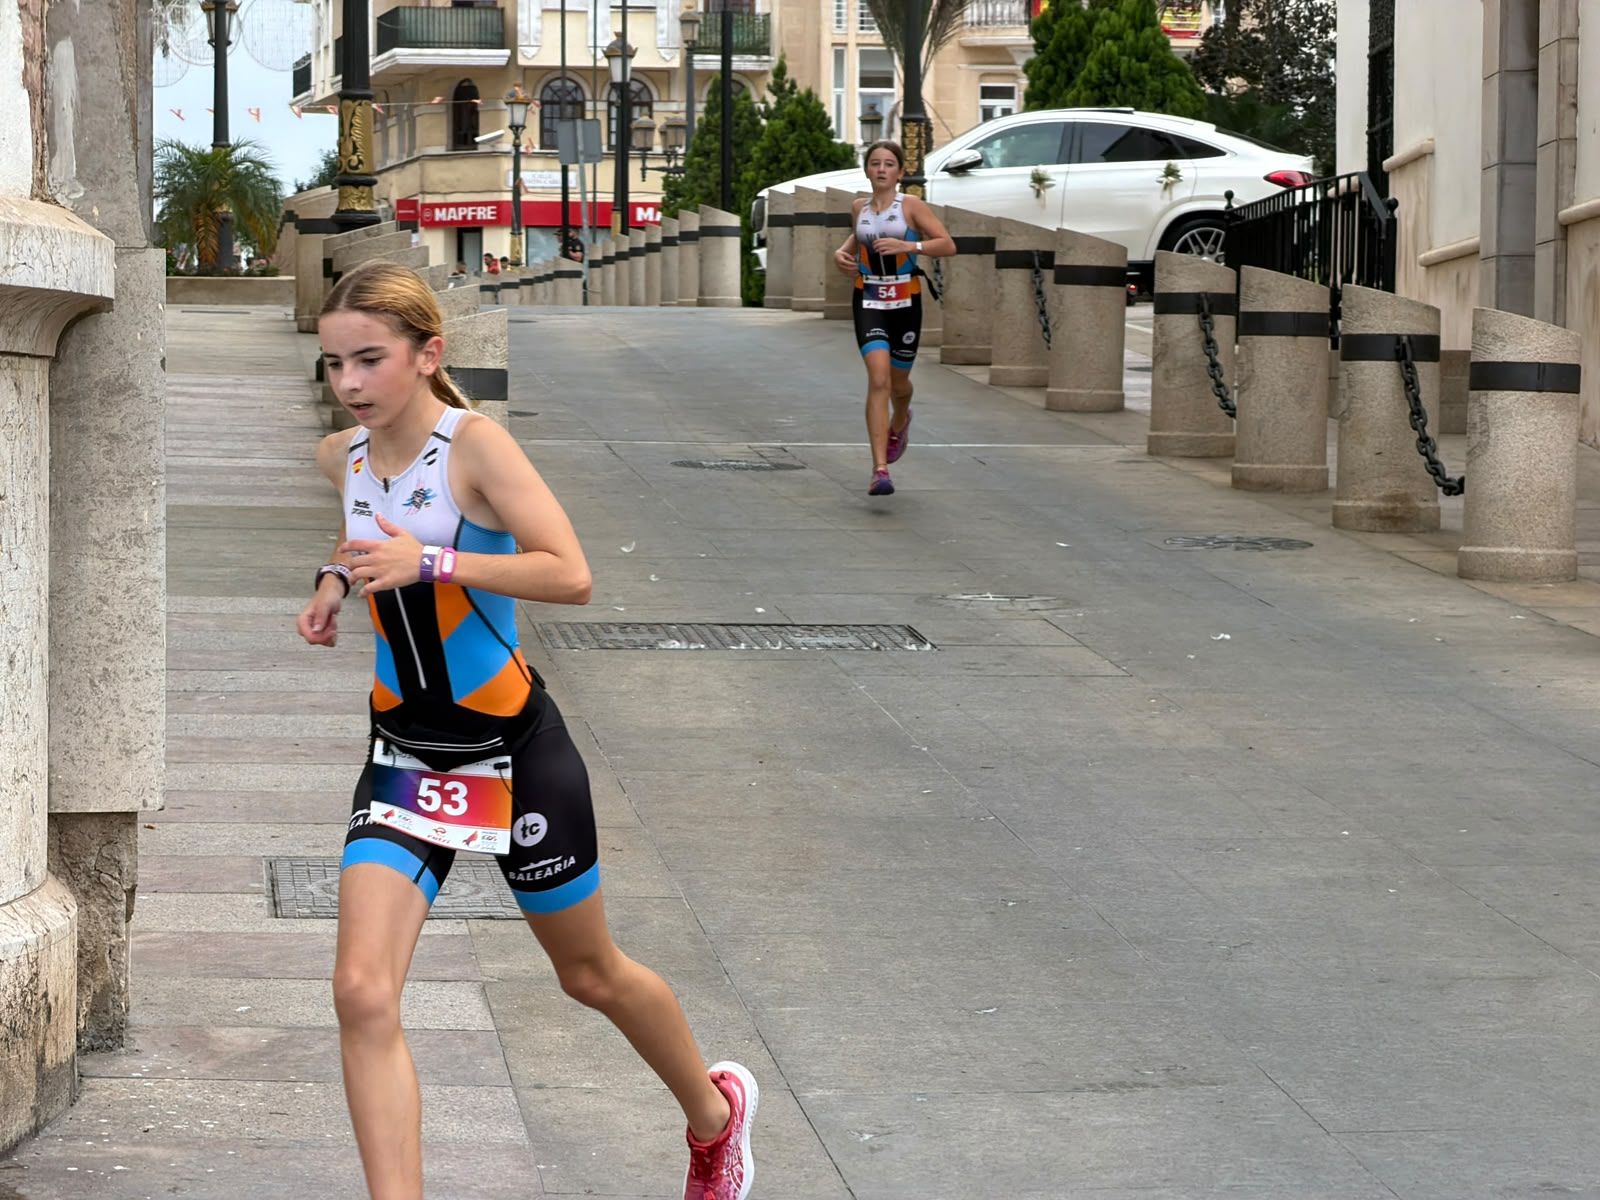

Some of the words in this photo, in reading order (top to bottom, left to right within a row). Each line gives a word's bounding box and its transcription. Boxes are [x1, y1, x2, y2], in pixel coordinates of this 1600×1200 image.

[434, 206, 497, 222] MAPFRE
[878, 285, 897, 299] 54
[416, 777, 468, 816] 53
[520, 822, 541, 840] tc
[508, 855, 577, 881] BALEARIA
